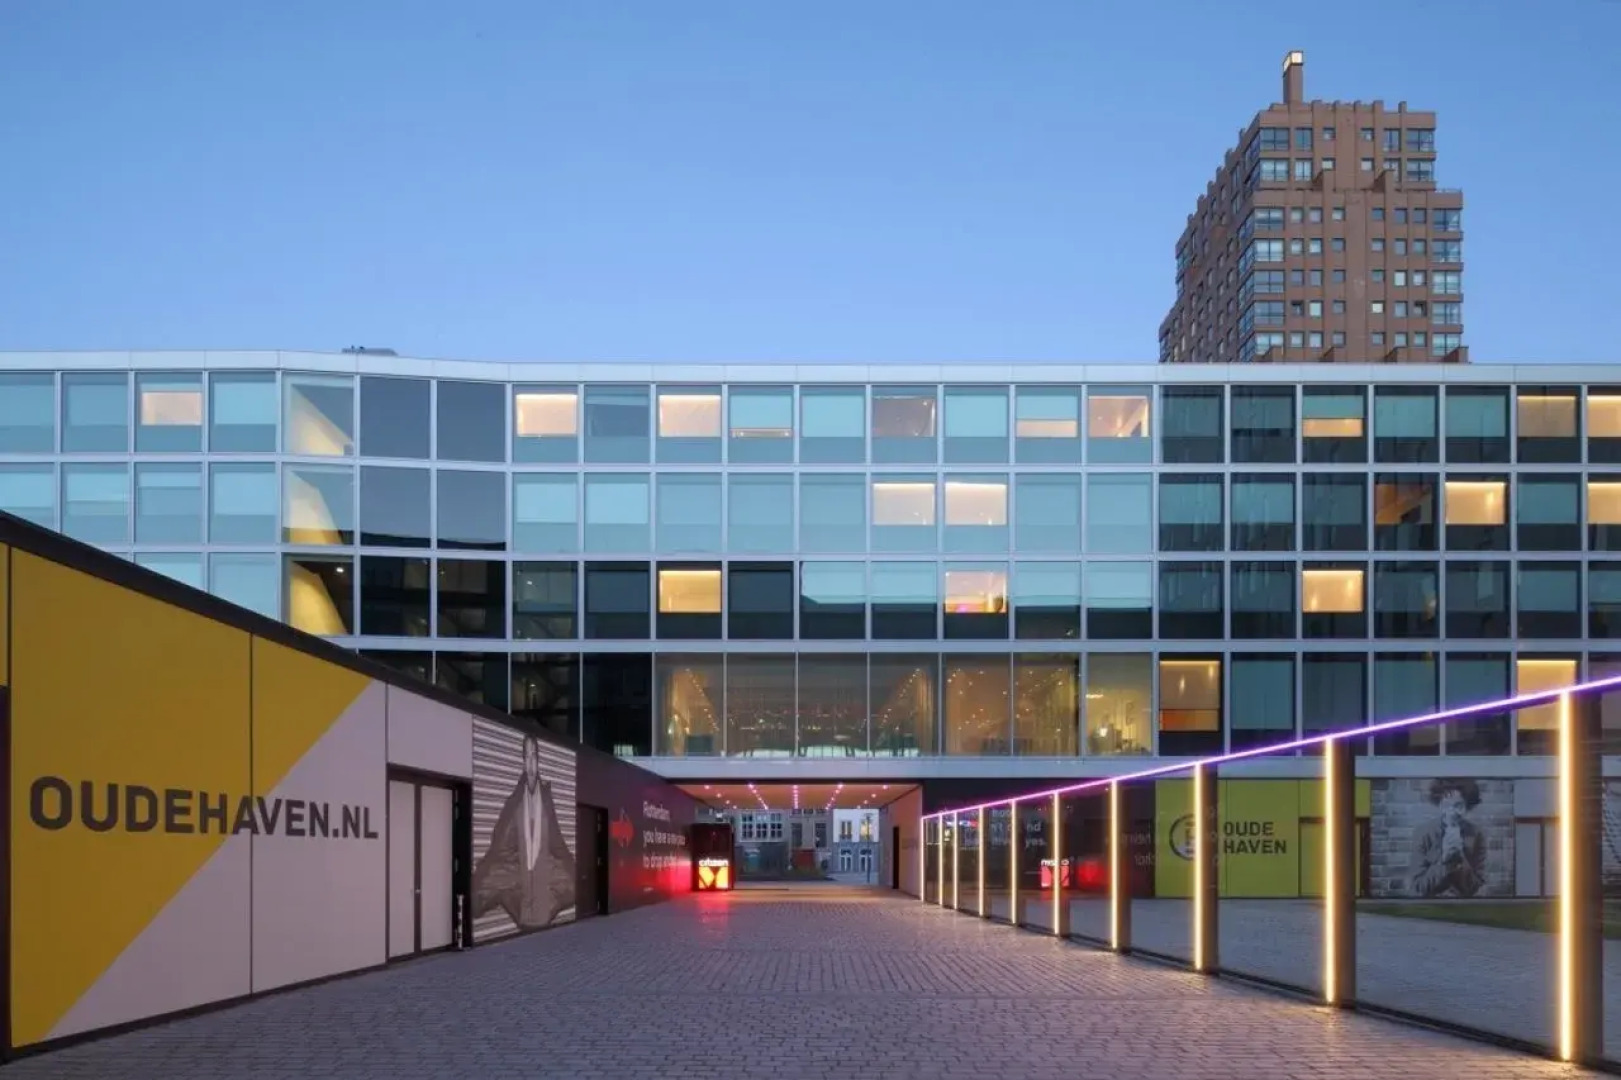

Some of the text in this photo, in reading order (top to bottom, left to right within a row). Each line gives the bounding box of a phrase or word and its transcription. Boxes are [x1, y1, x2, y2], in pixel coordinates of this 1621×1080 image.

[29, 775, 379, 839] OUDEHAVEN.NL
[1223, 821, 1274, 836] OUDE
[1223, 839, 1287, 854] HAVEN
